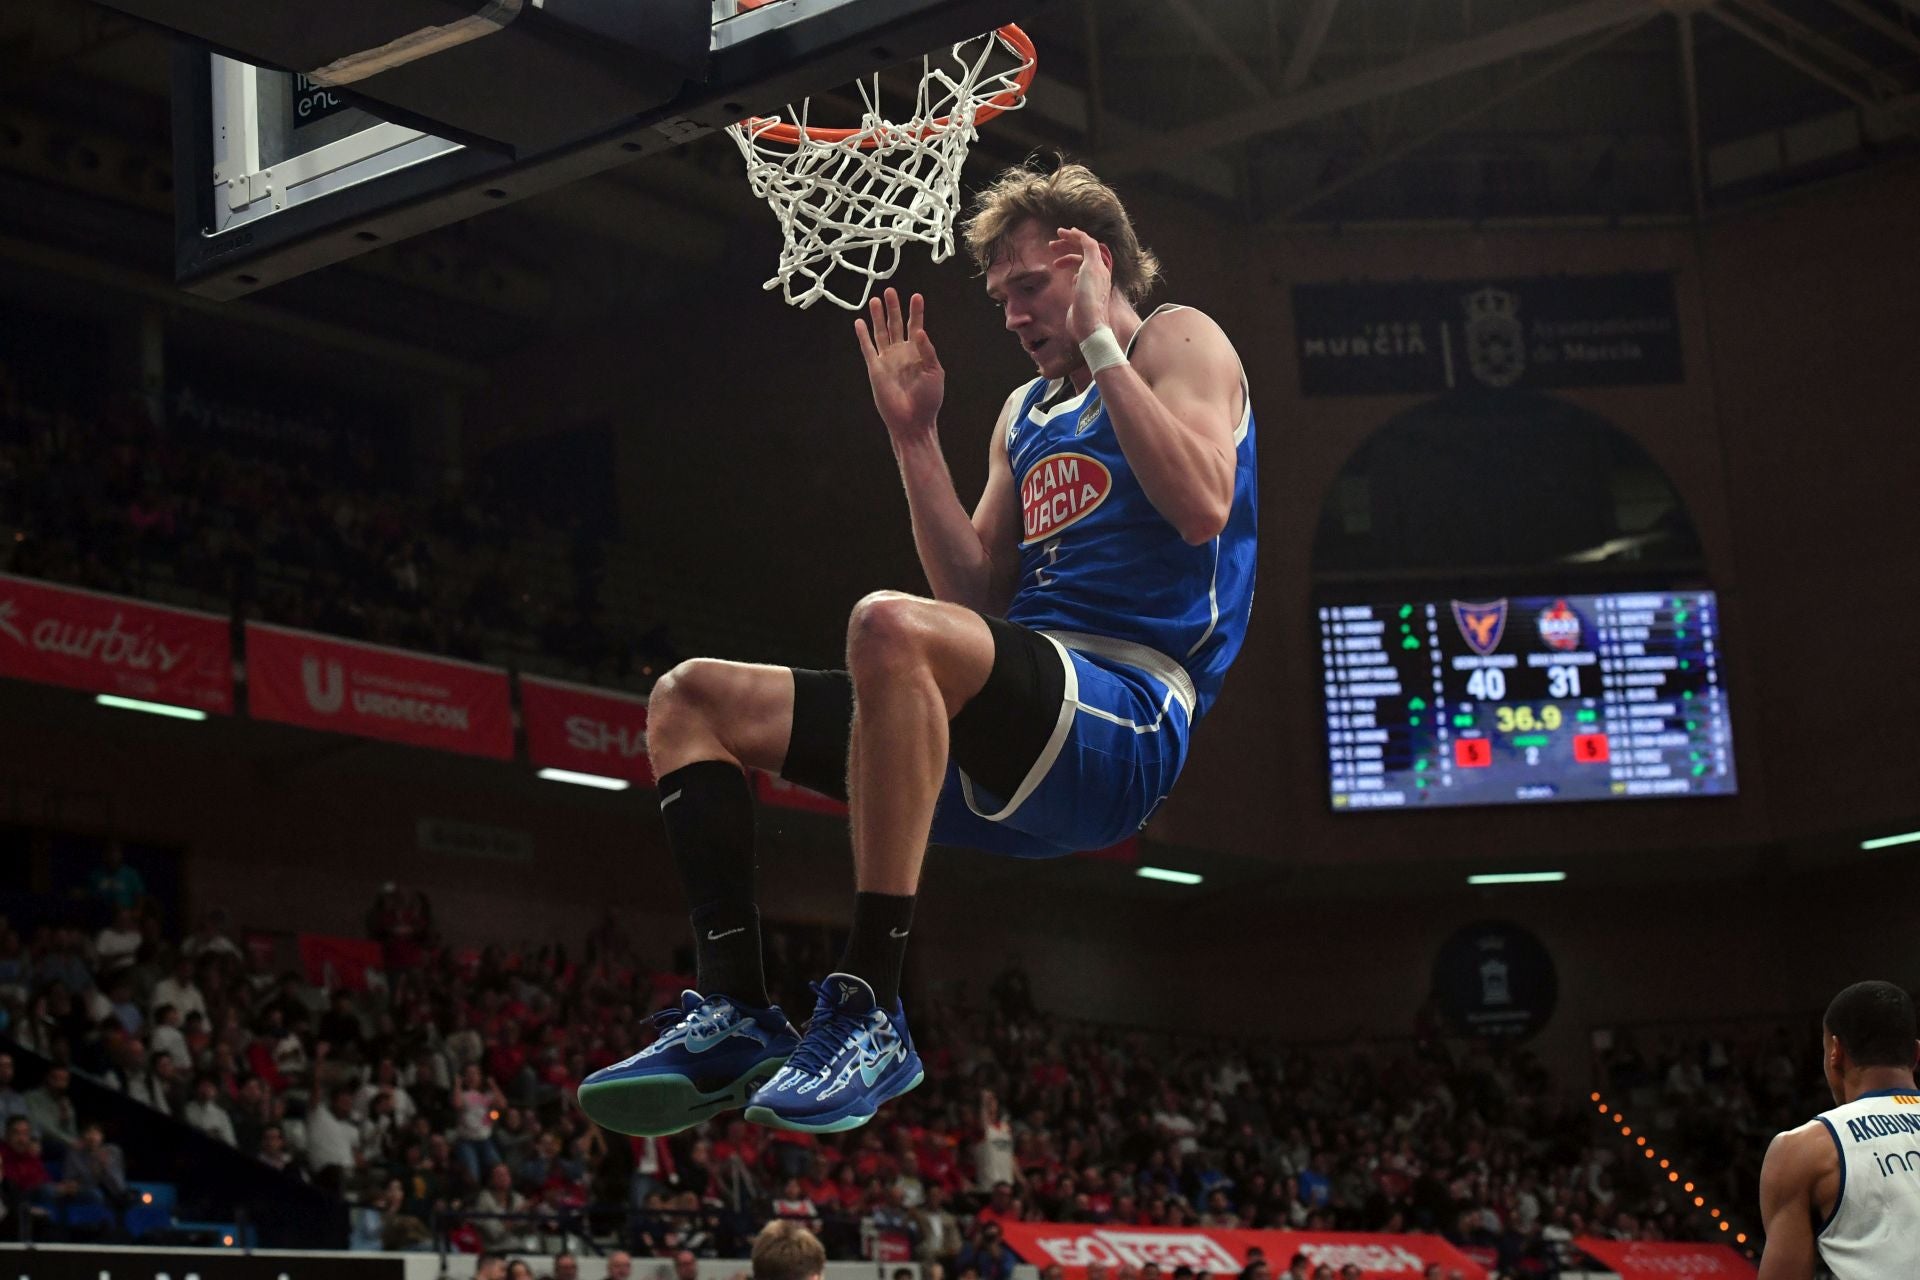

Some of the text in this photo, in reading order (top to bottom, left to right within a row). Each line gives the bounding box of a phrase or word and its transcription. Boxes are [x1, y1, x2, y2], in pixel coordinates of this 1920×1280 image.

[1023, 459, 1080, 511] UCAM
[1024, 483, 1099, 537] URCIA
[1466, 668, 1506, 701] 40
[1547, 665, 1581, 698] 31
[1496, 704, 1562, 733] 36.9
